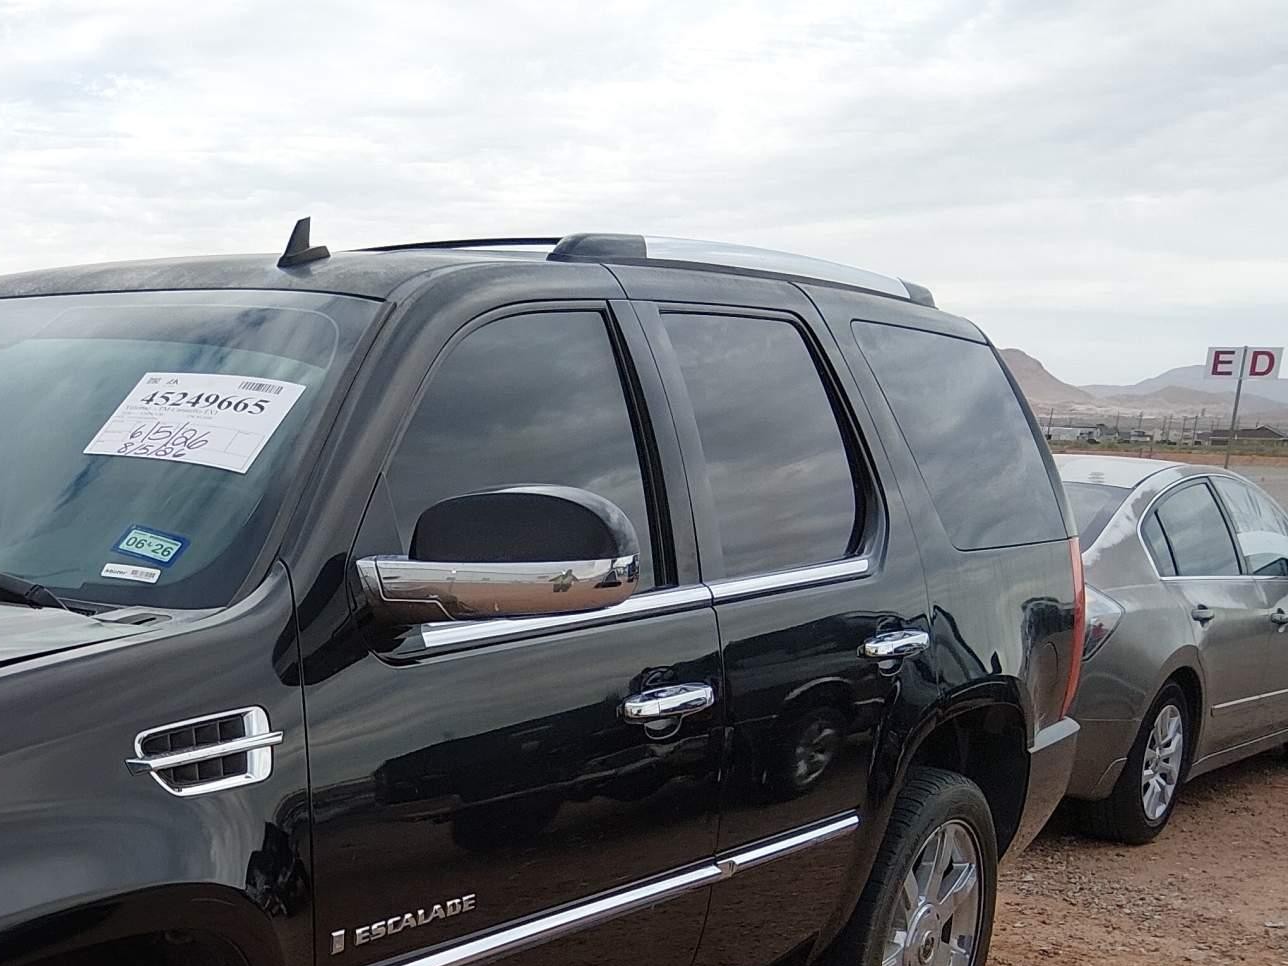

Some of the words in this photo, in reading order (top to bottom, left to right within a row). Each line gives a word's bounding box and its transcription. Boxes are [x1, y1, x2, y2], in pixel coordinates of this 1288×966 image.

[1211, 350, 1236, 376] E
[1249, 350, 1276, 377] D
[140, 390, 272, 416] 45249665
[125, 536, 148, 549] 06
[151, 543, 174, 557] 26
[355, 893, 477, 946] ESCALADE
